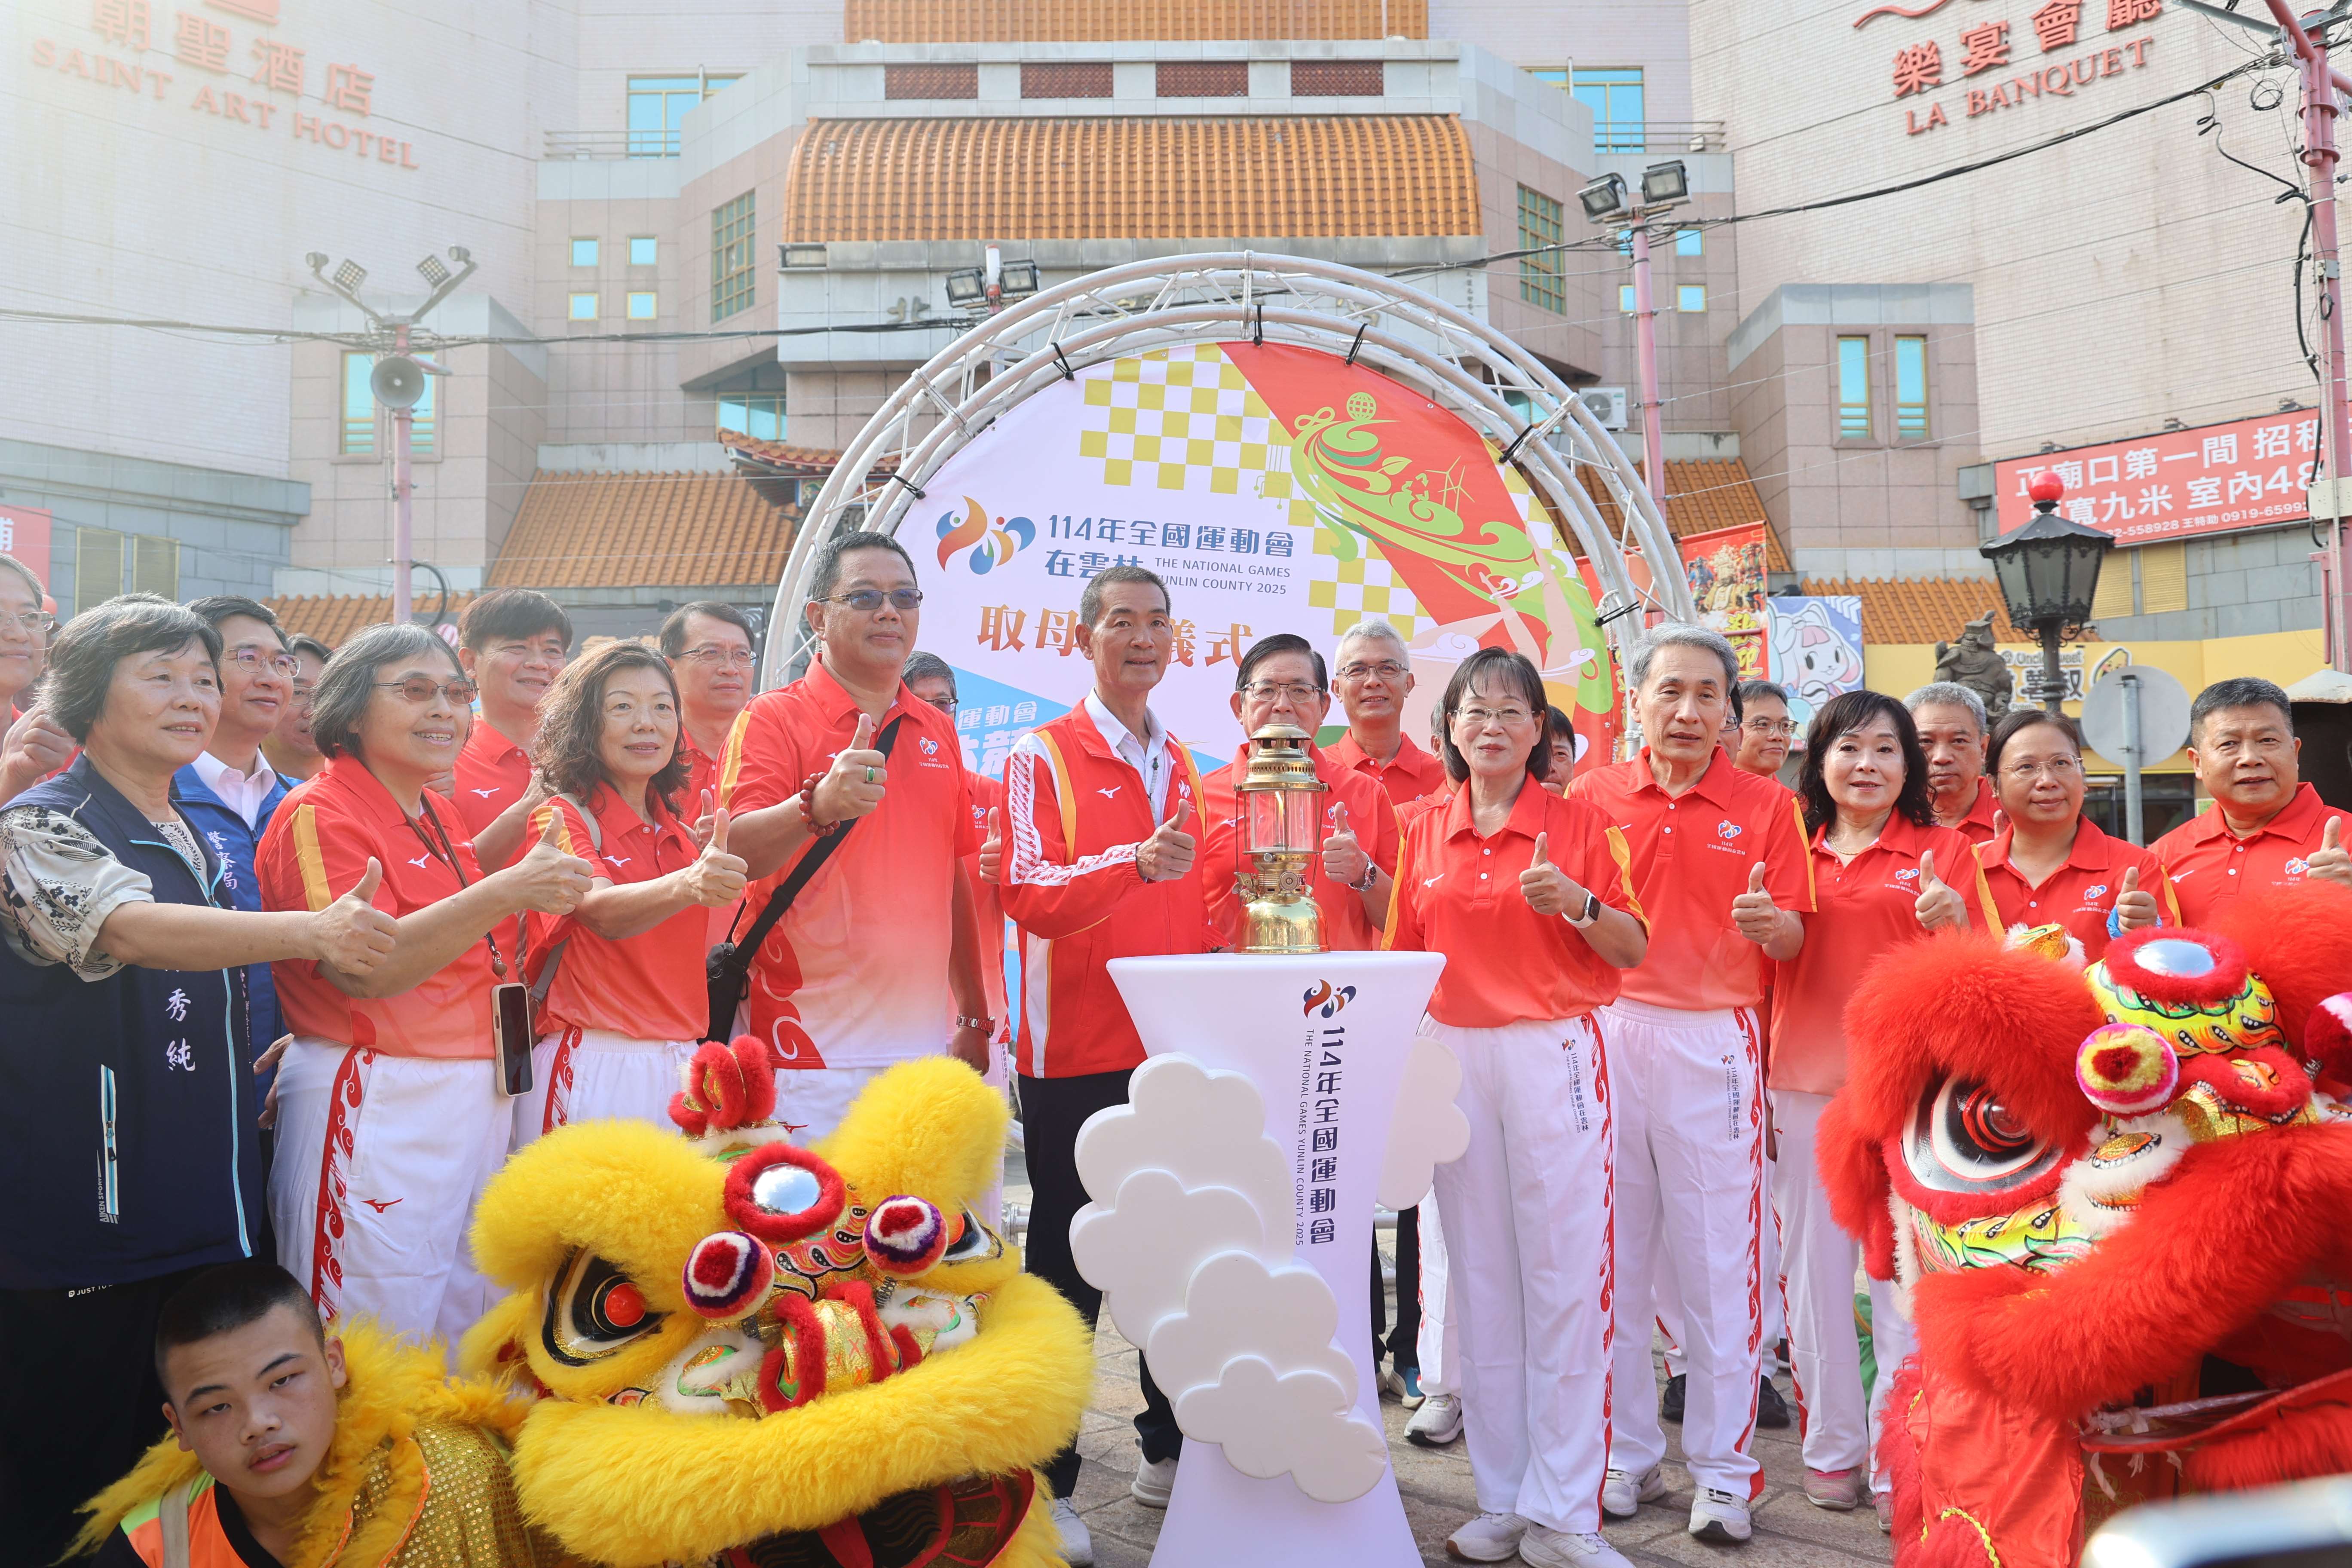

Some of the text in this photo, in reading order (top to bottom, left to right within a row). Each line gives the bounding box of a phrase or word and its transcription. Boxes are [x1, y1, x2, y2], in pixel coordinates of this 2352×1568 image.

[92, 0, 375, 116] 朝聖酒店
[1906, 36, 2153, 135] LA BANQUET
[33, 37, 420, 170] SAINT ART HOTEL
[1048, 514, 1294, 558] 114年全國運動會
[1155, 557, 1290, 578] THE NATIONAL GAMES
[1161, 575, 1286, 594] UNLIN COUNTY 2025
[207, 831, 238, 890] 警察局
[1295, 1029, 1314, 1246] THE NATIONAL GAMES YUNLIN COUNTY 2025
[1309, 1026, 1345, 1245] 114年全國運動會
[77, 1286, 96, 1296] JUST
